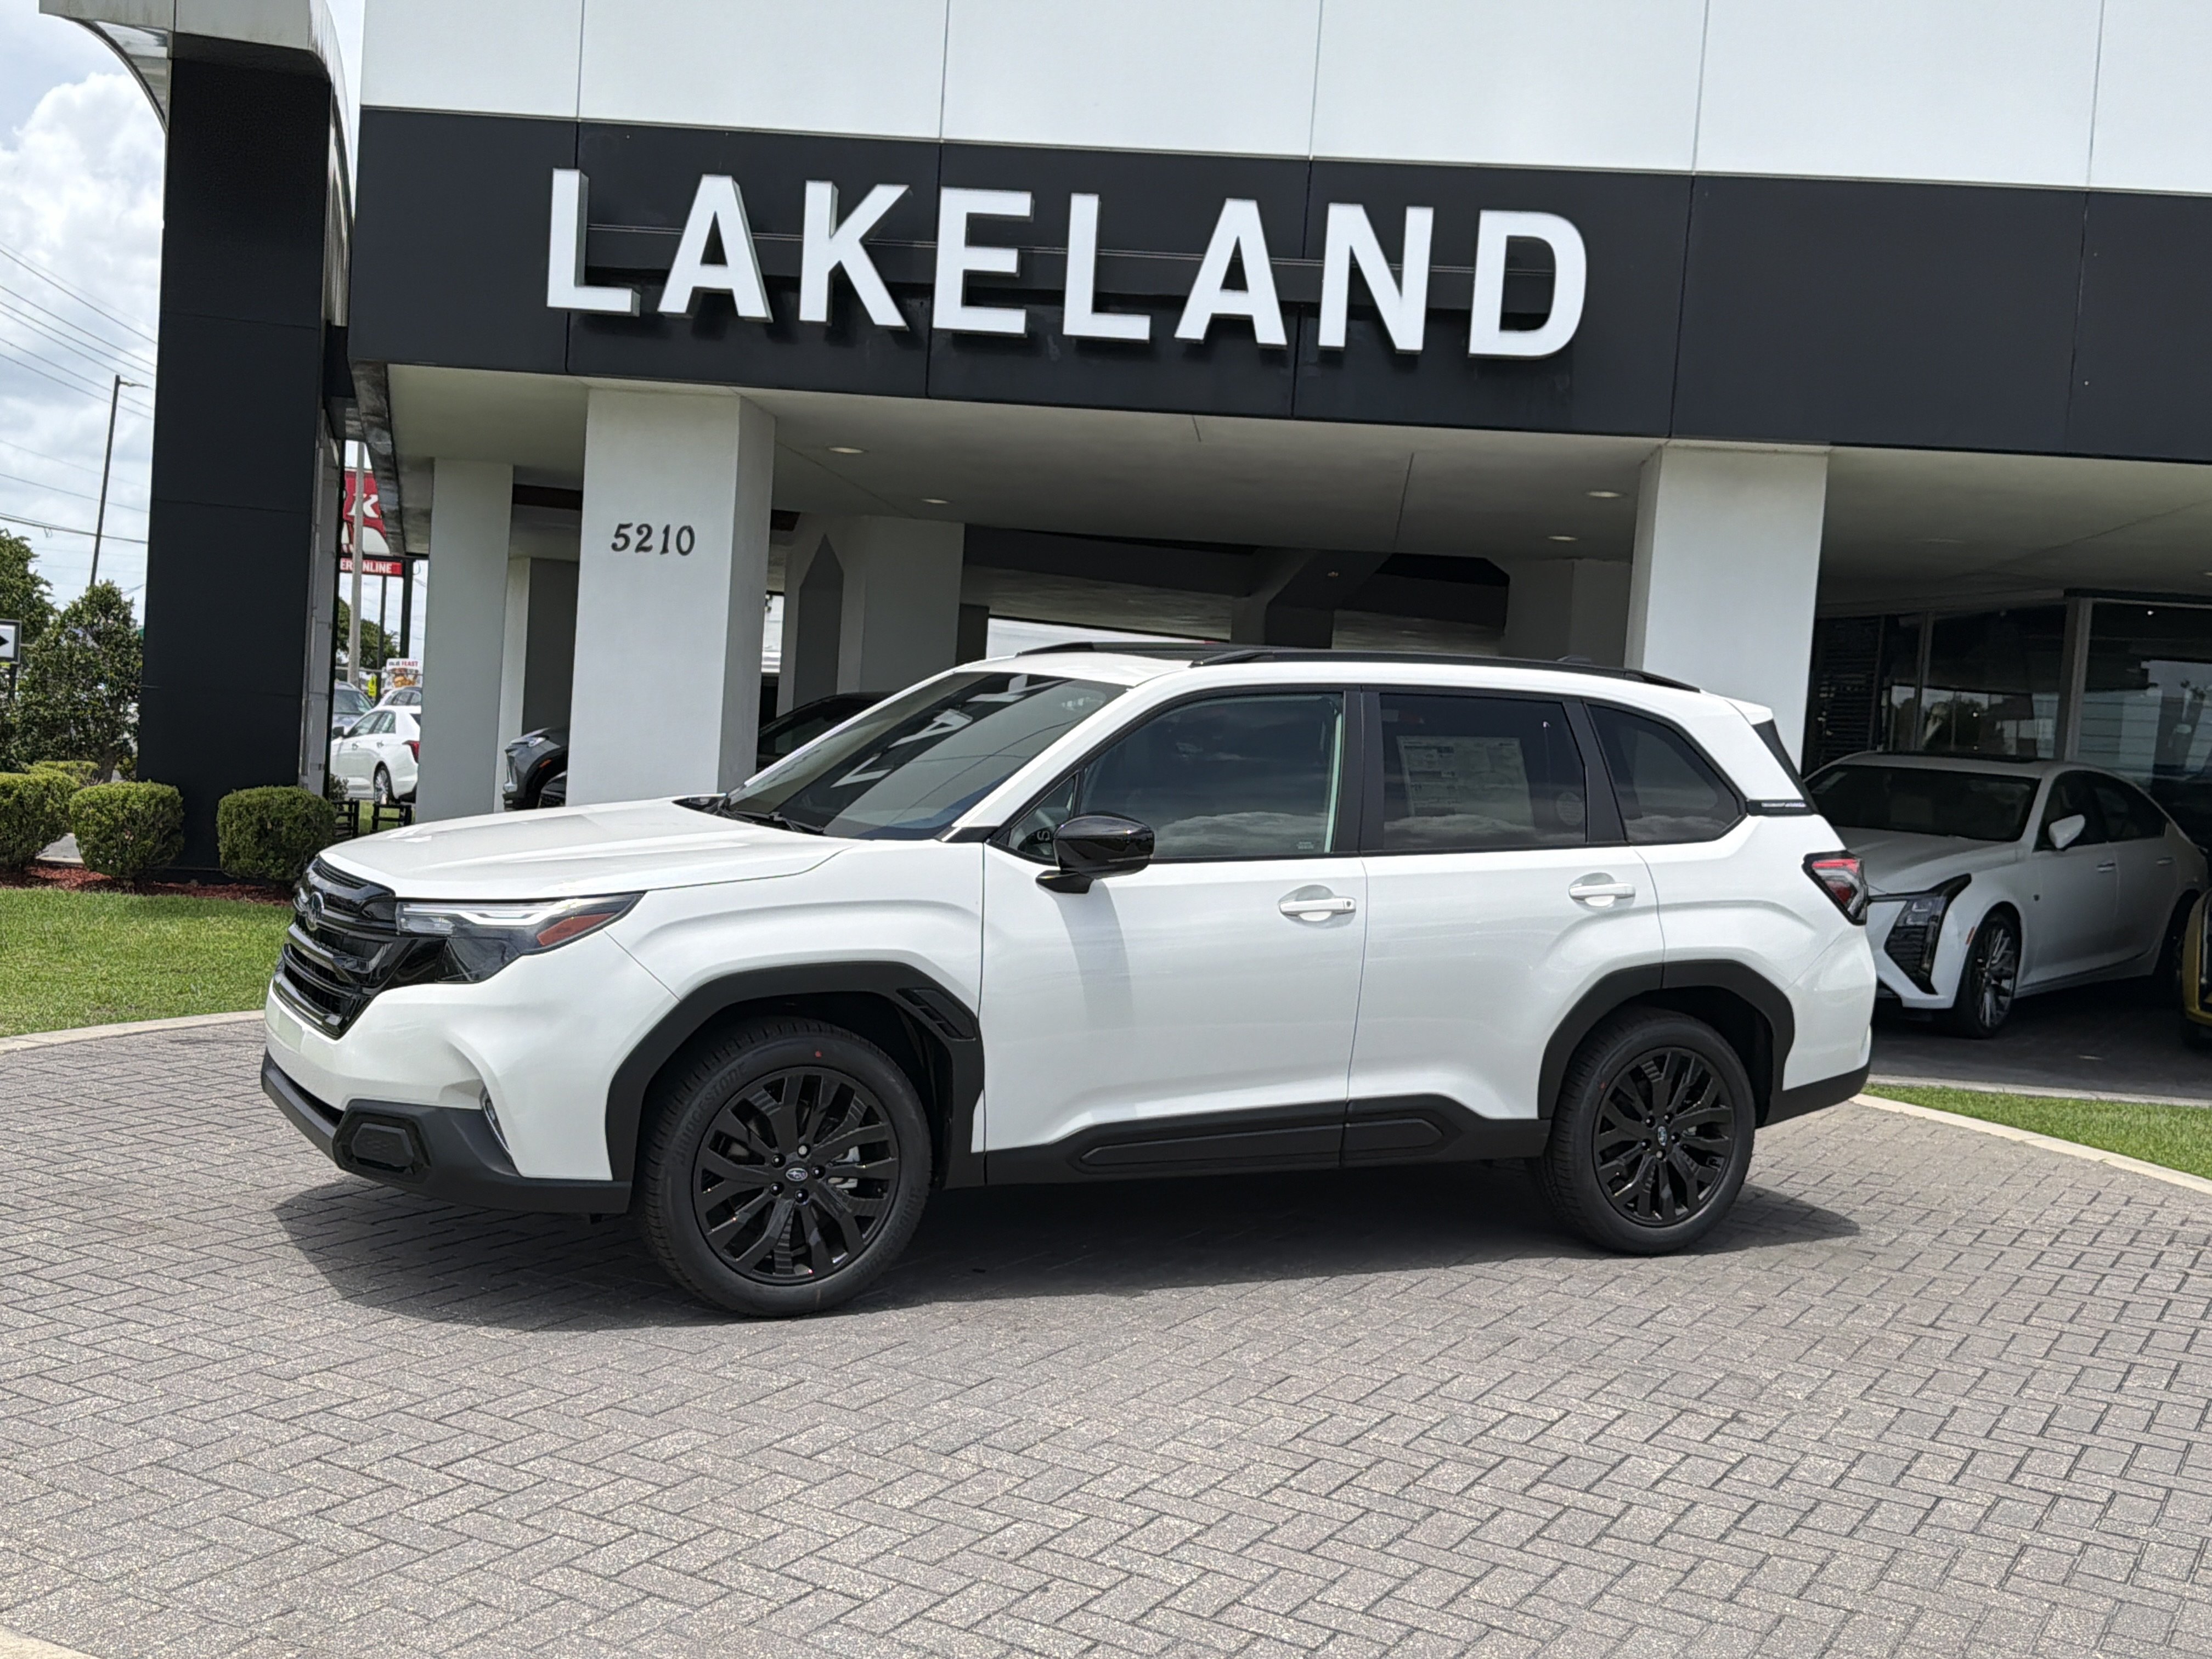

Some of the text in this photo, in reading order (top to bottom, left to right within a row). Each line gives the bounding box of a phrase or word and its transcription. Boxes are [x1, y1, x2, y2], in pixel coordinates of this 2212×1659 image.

[547, 167, 1587, 358] LAKELAND
[611, 522, 695, 556] 5210
[361, 560, 392, 573] NLINE
